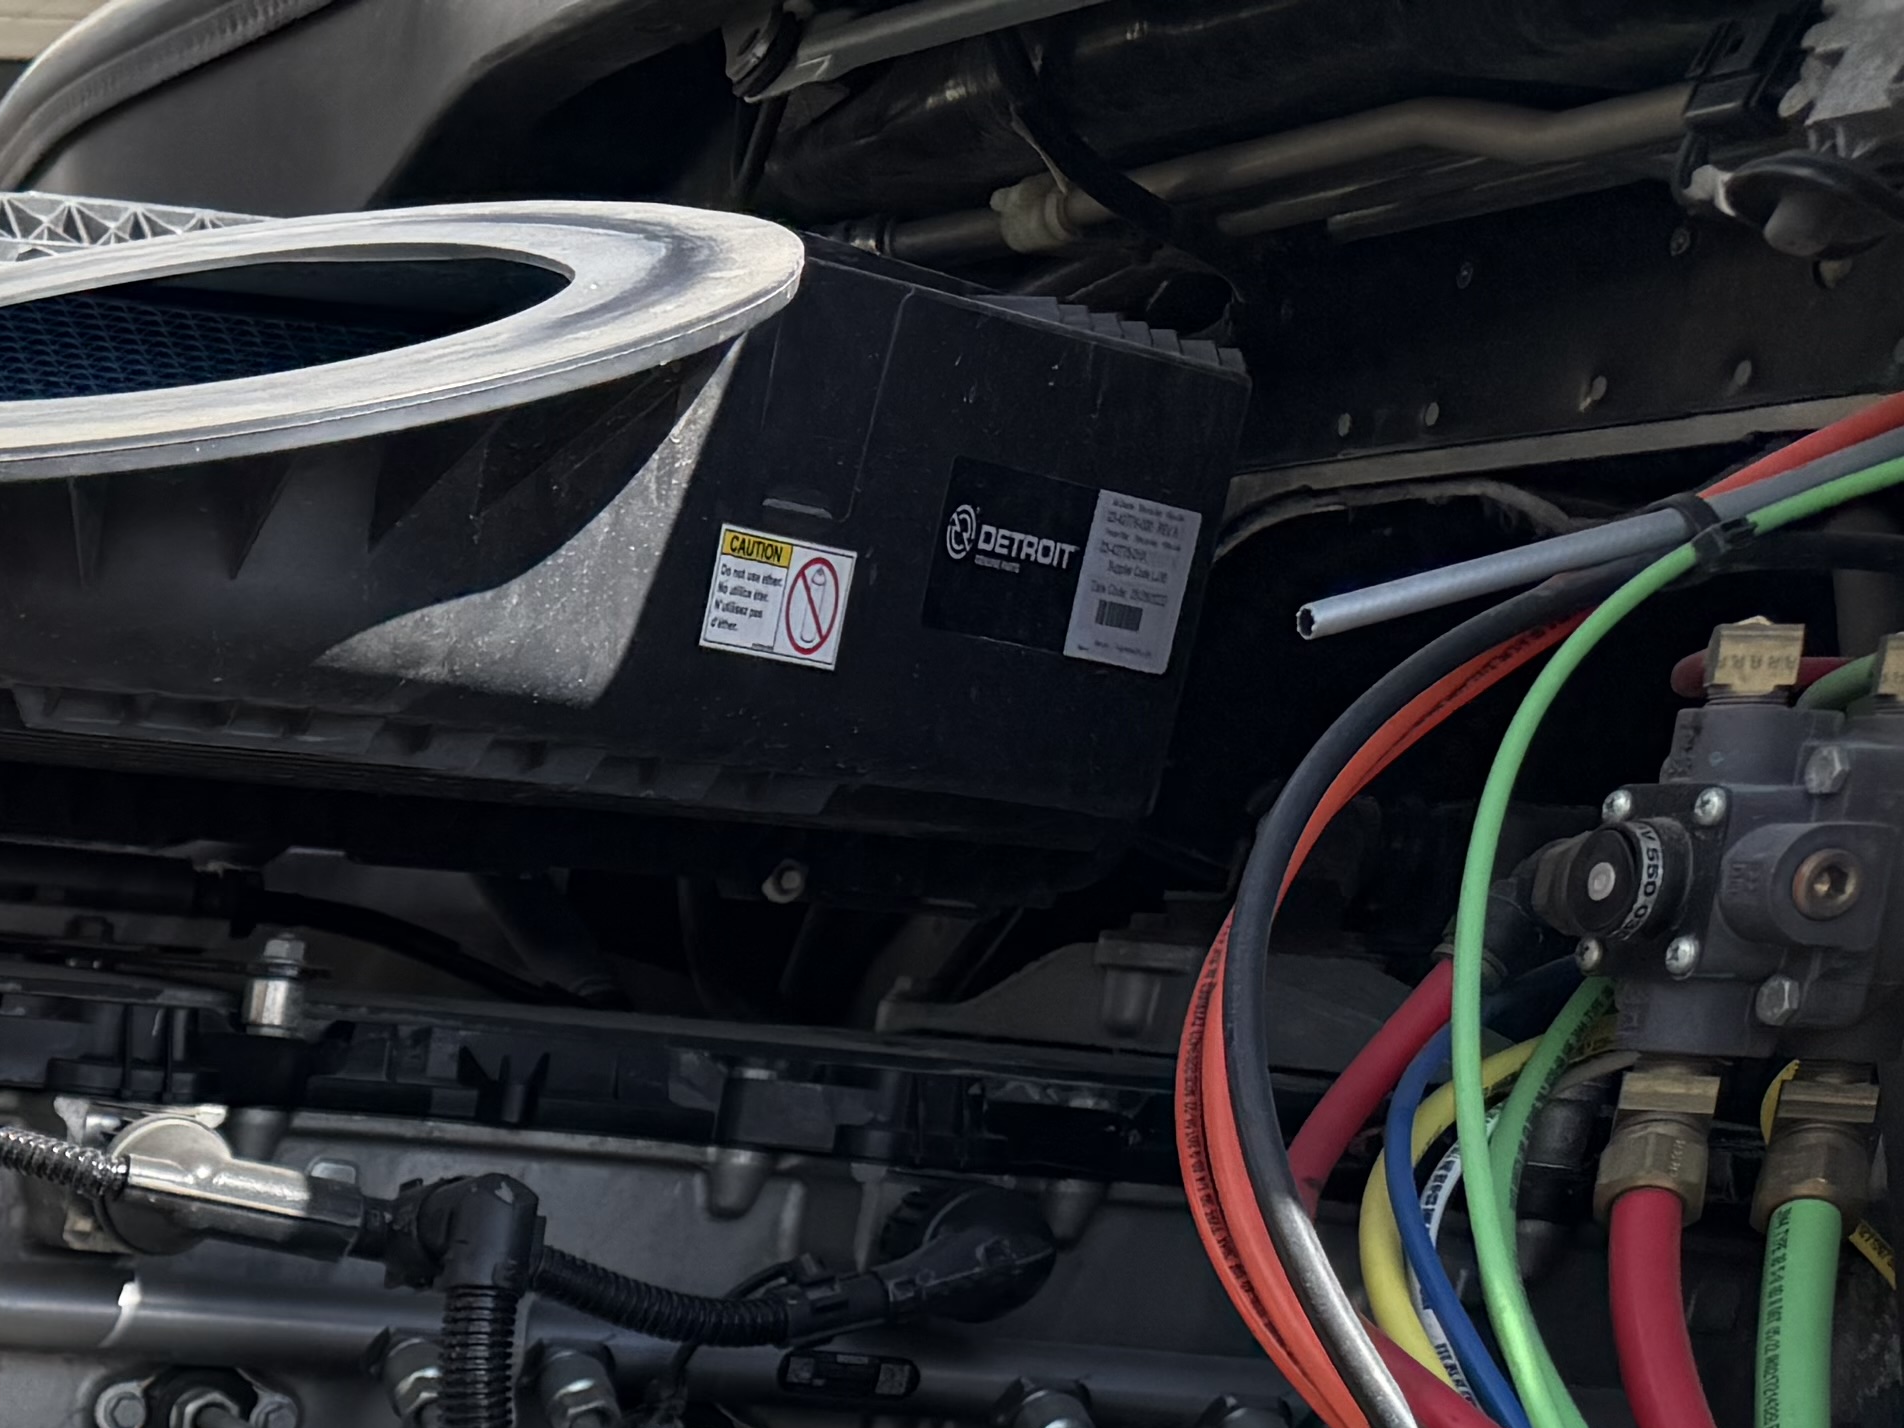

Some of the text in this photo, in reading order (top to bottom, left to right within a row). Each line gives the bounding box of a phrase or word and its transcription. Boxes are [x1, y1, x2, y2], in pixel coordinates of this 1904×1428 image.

[730, 535, 783, 562] CAUTION
[978, 525, 1080, 569] DETROIT
[721, 564, 731, 575] Do
[734, 568, 745, 577] not
[1644, 848, 1659, 896] 550
